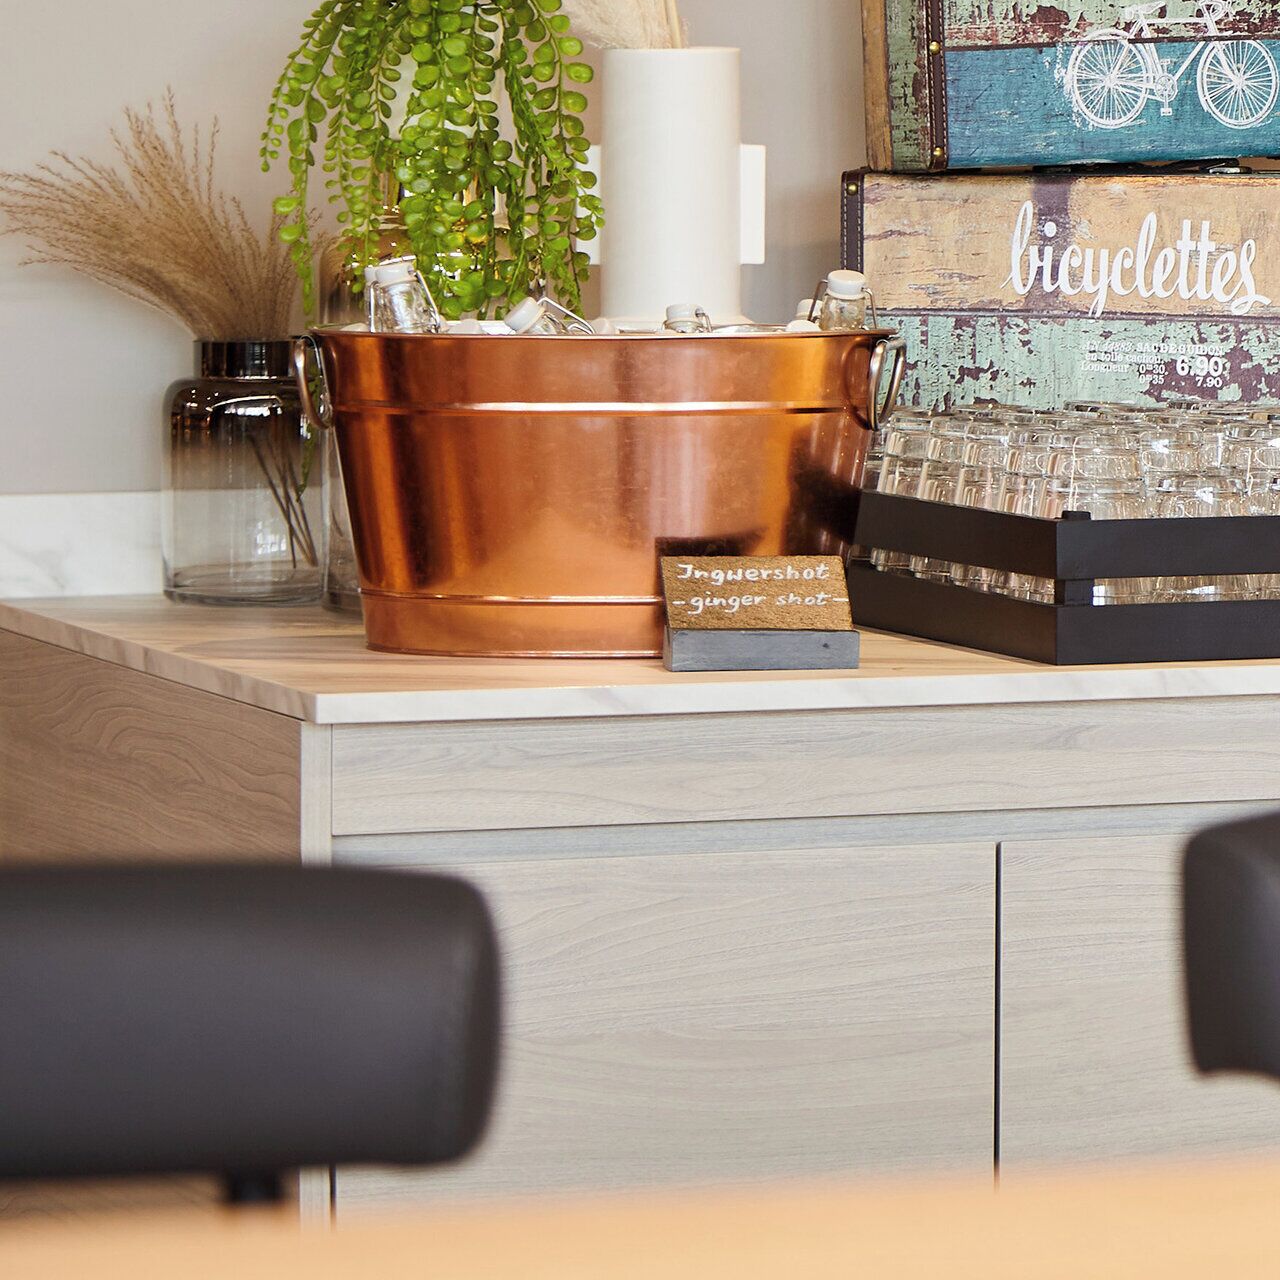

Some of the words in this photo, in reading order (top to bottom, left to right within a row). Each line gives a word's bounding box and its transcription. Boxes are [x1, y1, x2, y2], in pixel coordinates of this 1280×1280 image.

[1000, 200, 1272, 318] bicyclettes
[1175, 355, 1224, 377] 6.90
[1195, 376, 1223, 388] 7.90
